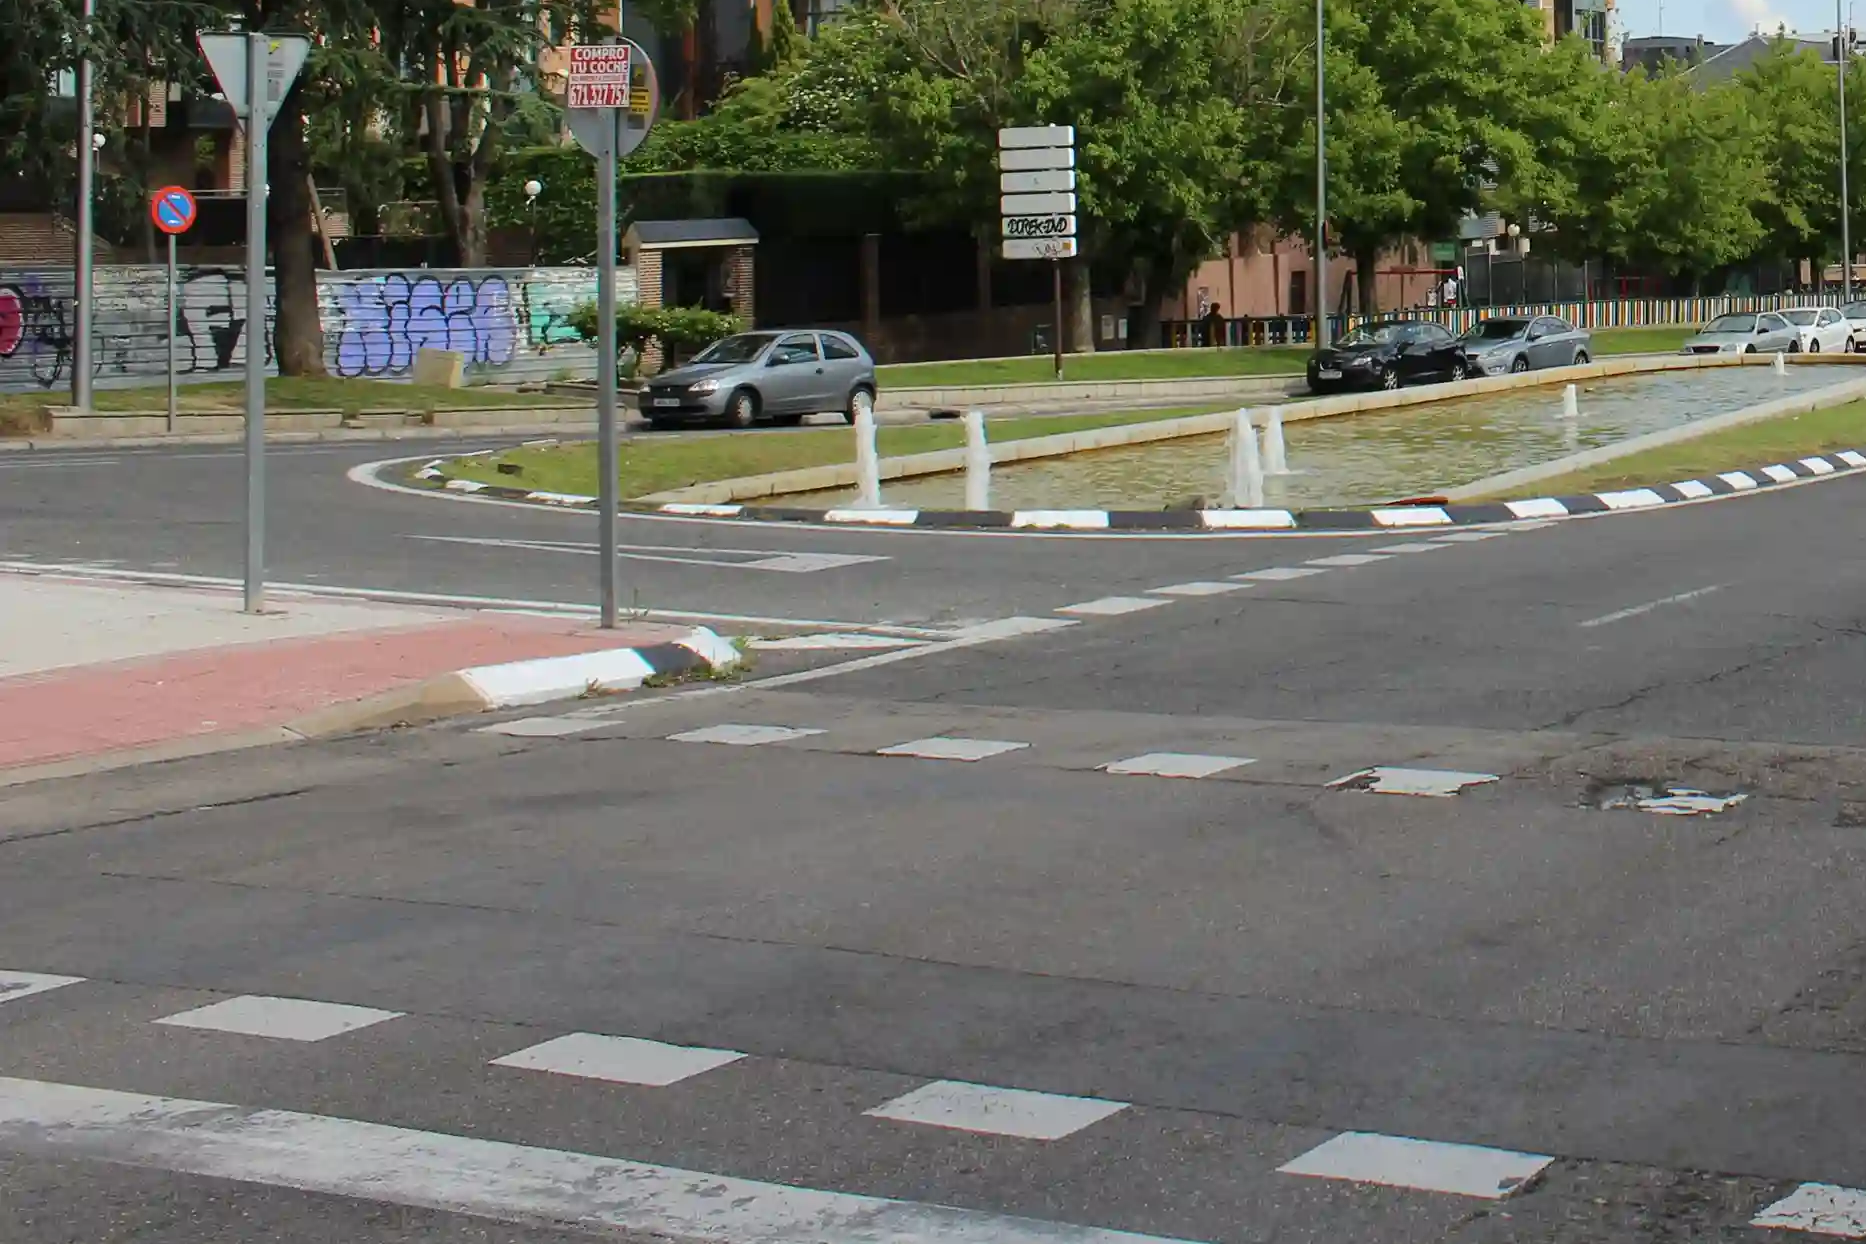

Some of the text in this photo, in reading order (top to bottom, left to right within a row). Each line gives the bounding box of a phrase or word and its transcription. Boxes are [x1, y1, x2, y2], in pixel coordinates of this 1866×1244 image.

[575, 48, 625, 60] COMPRO
[571, 61, 628, 73] TU COCHE
